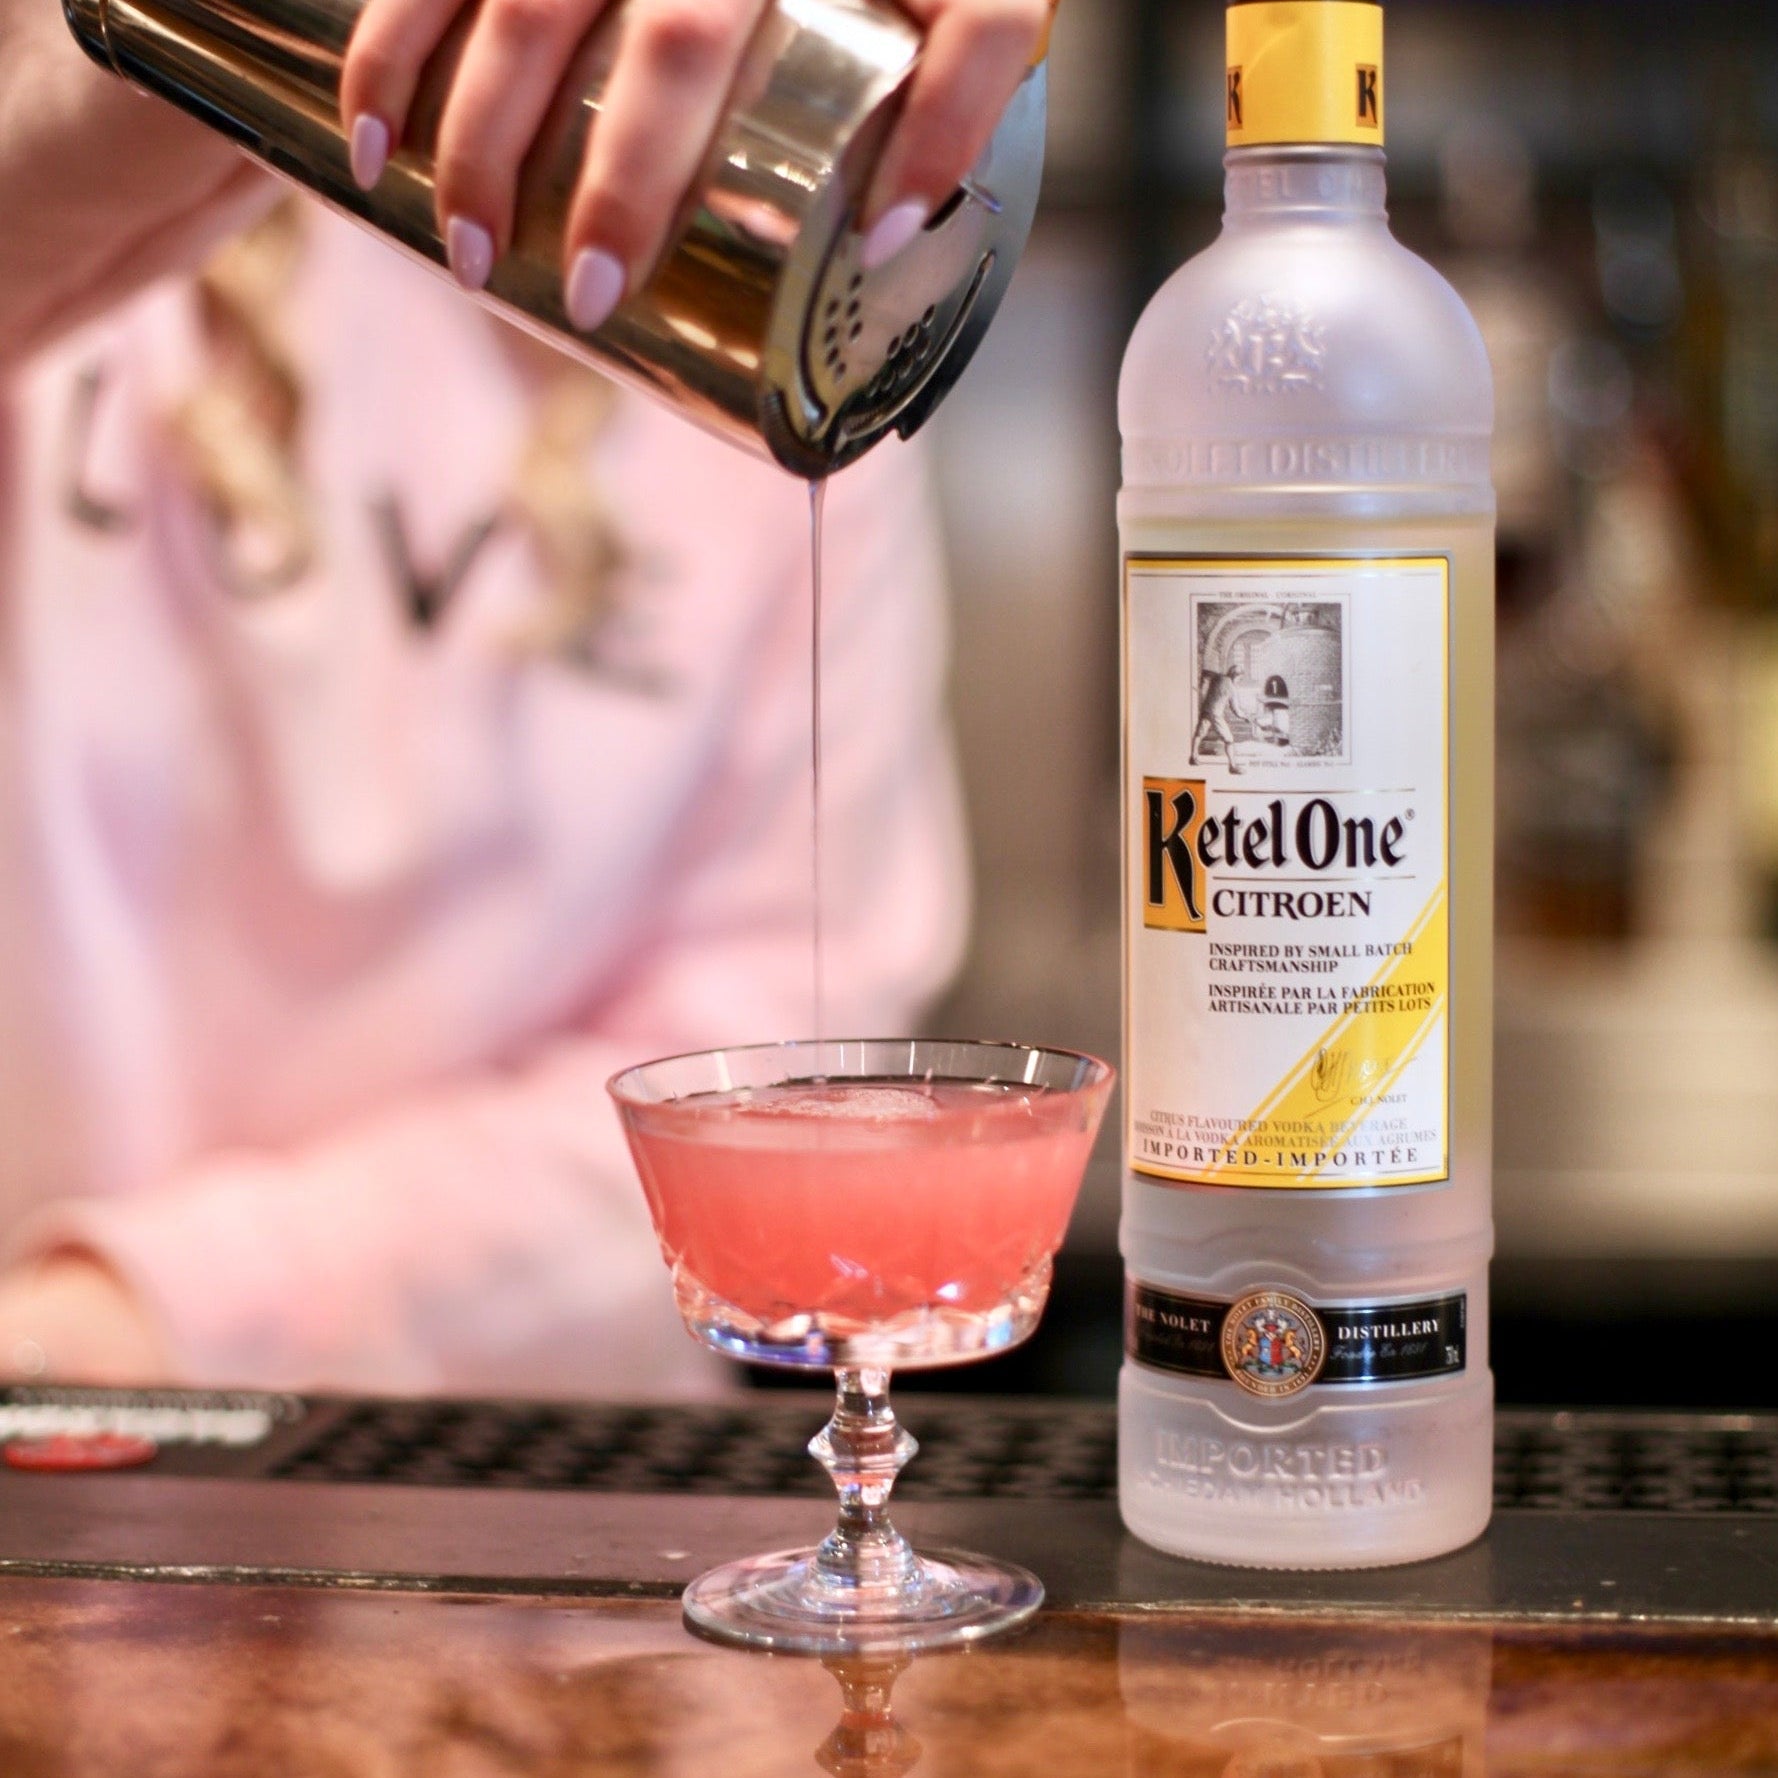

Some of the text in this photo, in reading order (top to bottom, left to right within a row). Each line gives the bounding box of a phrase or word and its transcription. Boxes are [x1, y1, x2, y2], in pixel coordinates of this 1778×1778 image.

[1228, 71, 1242, 124] K
[1357, 69, 1378, 124] K
[1146, 789, 1405, 920] Ketel One
[1211, 889, 1373, 920] CITROEN
[1208, 942, 1413, 958] INSPIRED BY SMALL BATCH
[1208, 958, 1339, 973] CRAFTSMANSHIP
[1208, 982, 1436, 1000] INSPIRÉE PAR LA FABRICATION
[1208, 997, 1432, 1015] ARTISANALE PAR PETITS LOTS
[1150, 1110, 1186, 1127] CITRUS
[1187, 1114, 1269, 1133] FLAVOURED
[1273, 1120, 1326, 1133] VODKA
[1176, 1128, 1191, 1142] LA
[1194, 1131, 1240, 1146] VODKA
[1378, 1128, 1438, 1146] AGRUMES
[1160, 1311, 1211, 1333] NOLET
[1338, 1318, 1440, 1340] DISTILLERY
[1154, 1431, 1390, 1482] IMPORTED
